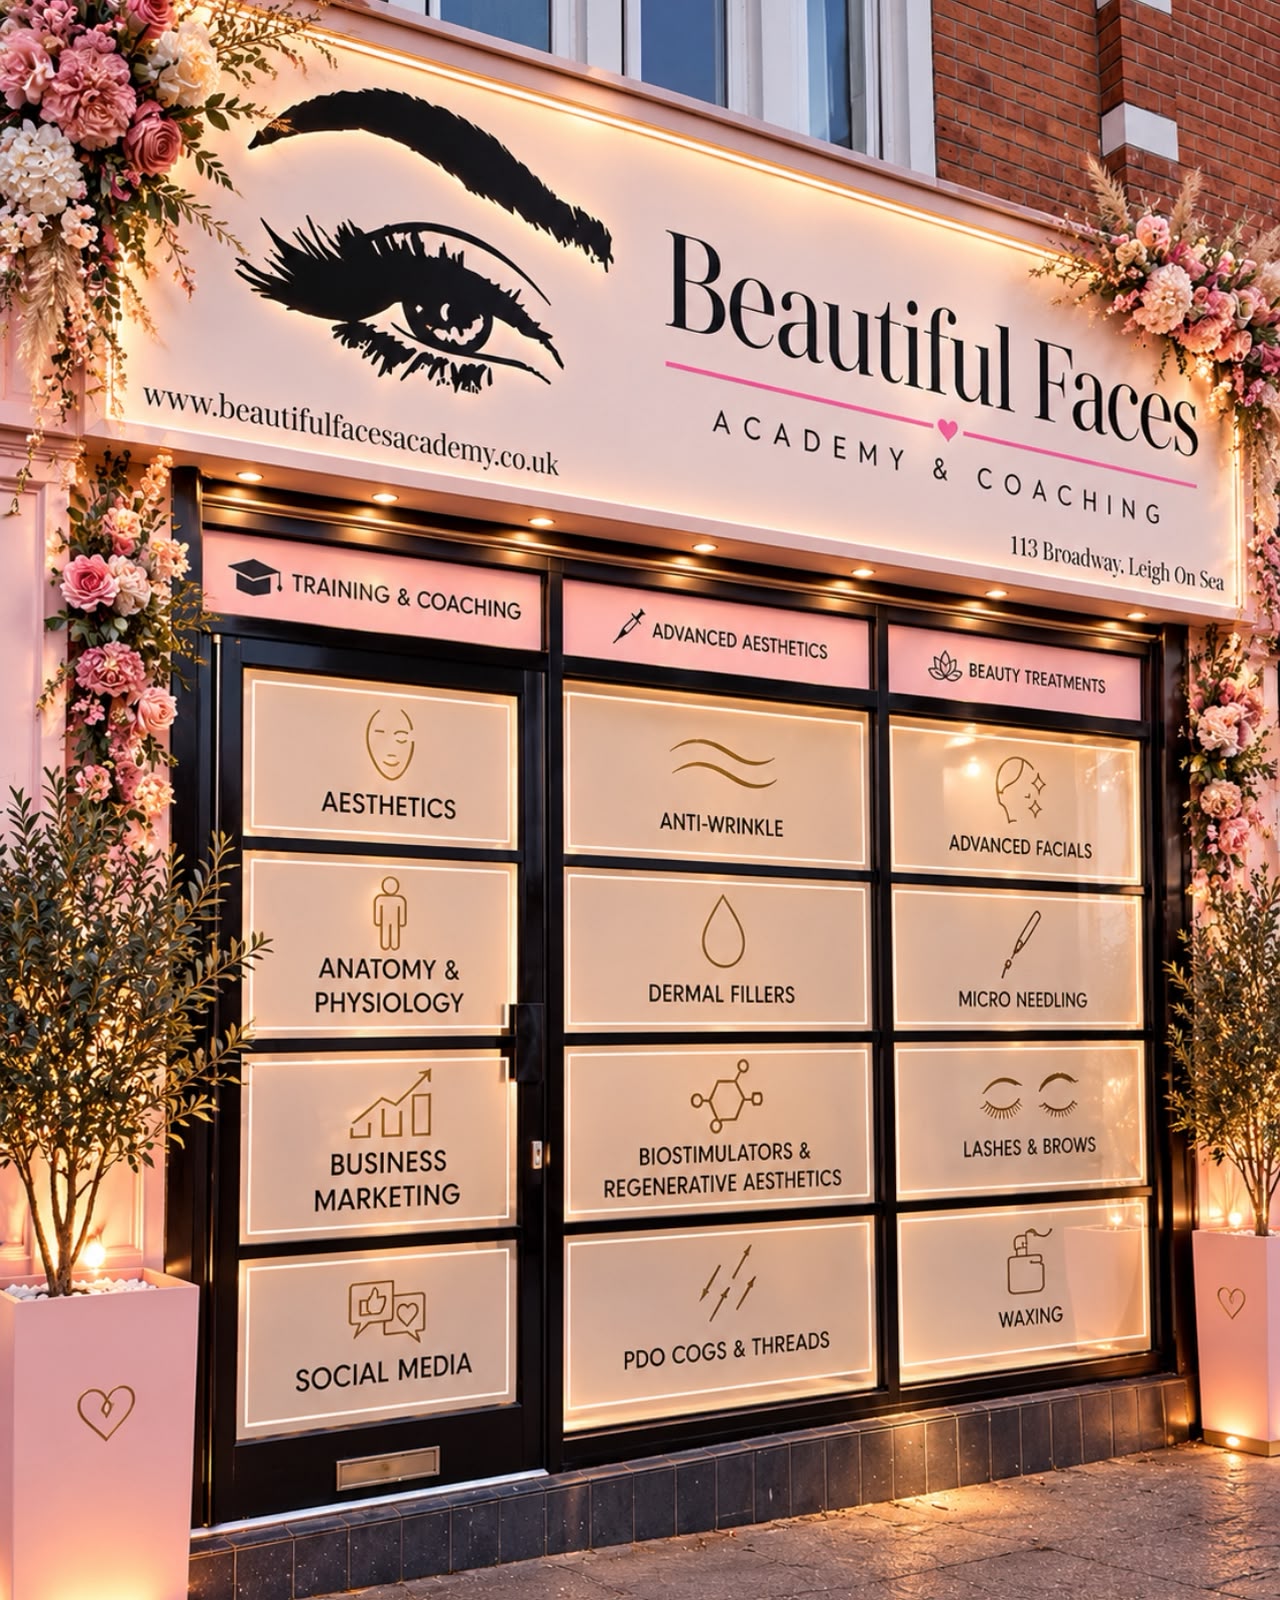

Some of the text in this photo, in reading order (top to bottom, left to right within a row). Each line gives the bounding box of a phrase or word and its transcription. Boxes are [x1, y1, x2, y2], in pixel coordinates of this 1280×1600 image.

[665, 229, 1200, 457] Beautiful Faces
[142, 385, 560, 476] www.beautifulfacesacademy.co.uk
[712, 410, 1160, 525] ACADEMY & COACHING
[1011, 535, 1038, 558] 113
[1129, 557, 1170, 585] Leigh
[1174, 566, 1196, 586] On
[1199, 570, 1224, 591] Sea
[291, 573, 522, 621] TRAINING & COACHING
[652, 622, 828, 660] ADVANCED AESTHETICS
[969, 662, 1106, 694] BEAUTY TREATMENTS
[321, 791, 457, 820] AESTHETICS
[659, 812, 784, 838] ANTI-WRINKLE
[948, 834, 1093, 860] ADVANCED FACIALS
[318, 957, 460, 981] ANATOMY &
[315, 991, 464, 1014] PHYSIOLOGY
[648, 983, 796, 1004] DERMAL FILLERS
[958, 990, 1088, 1009] MICRO NEEDLING
[639, 1141, 811, 1166] BIOSTIMULATORS &
[963, 1135, 1097, 1158] LASHES & BROWS
[330, 1149, 447, 1177] BUSINESS
[314, 1182, 461, 1213] MARKETING
[604, 1168, 842, 1199] REGENERATIVE AESTHETICS
[998, 1305, 1064, 1329] WAXING
[624, 1330, 830, 1371] PDO COGS & THREADS
[295, 1352, 473, 1393] SOCIAL MEDIA
